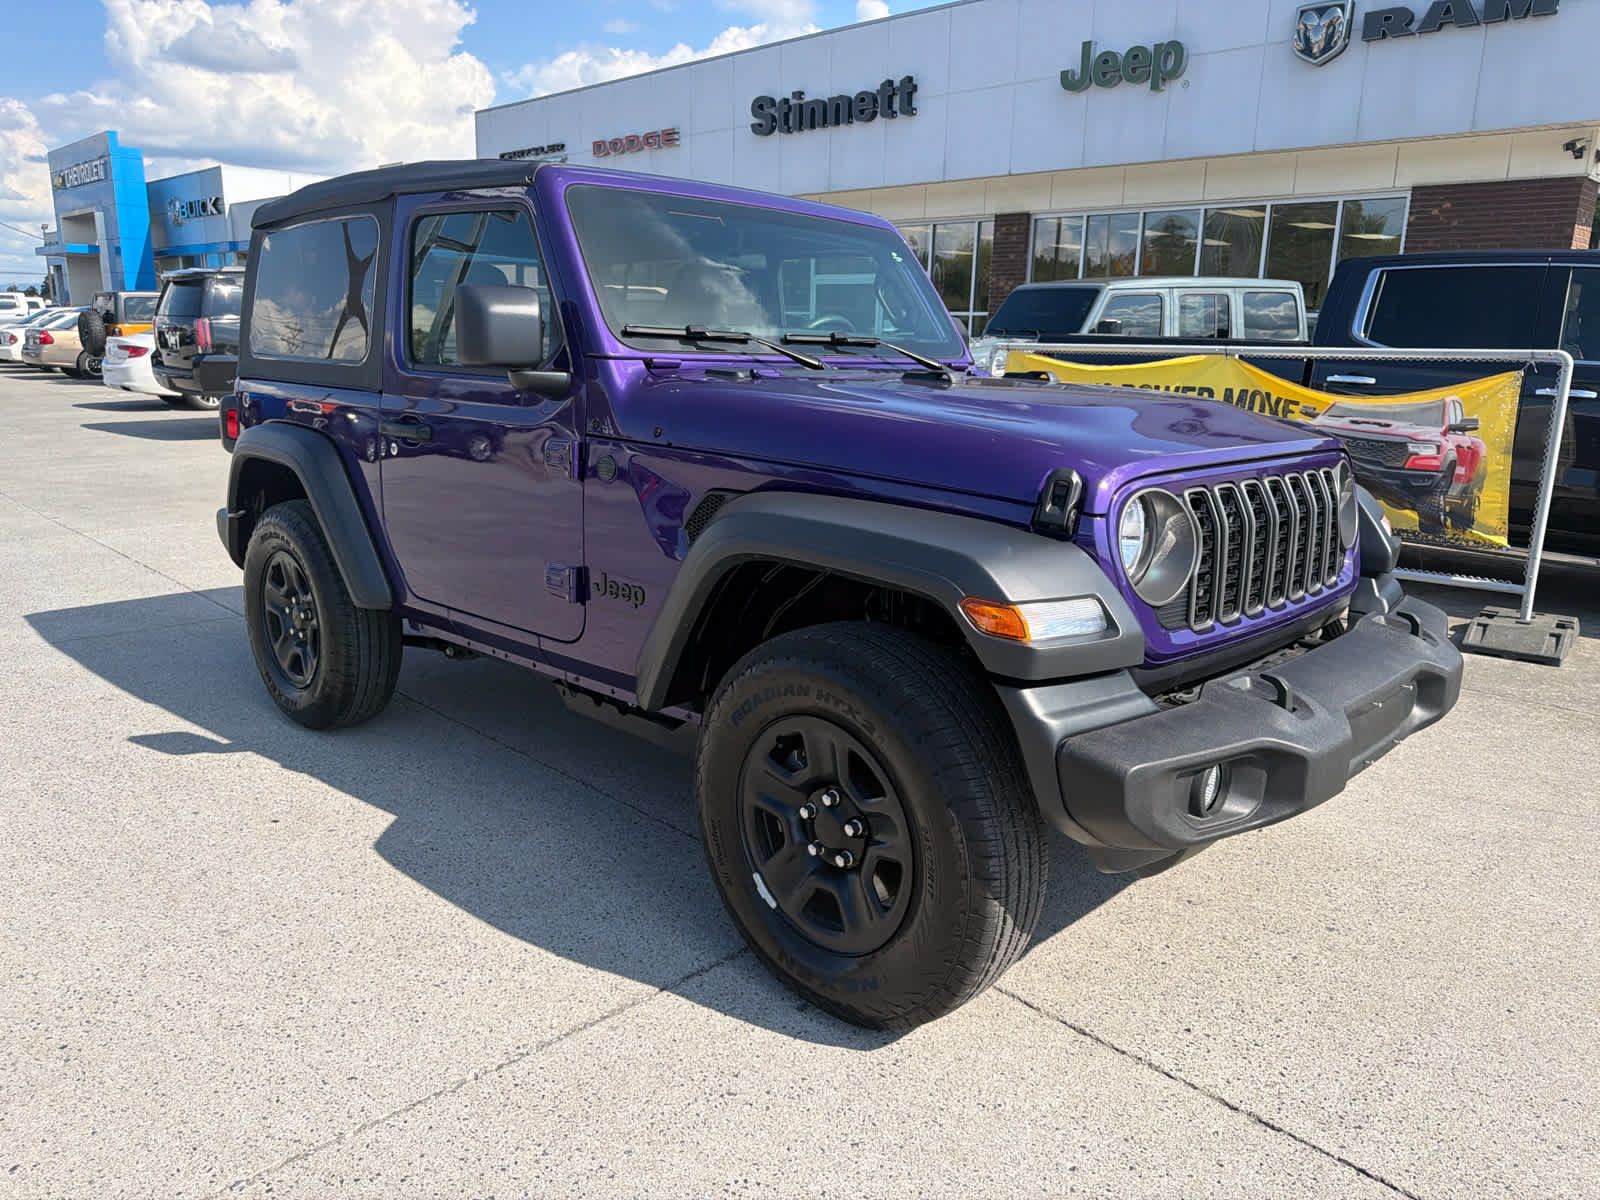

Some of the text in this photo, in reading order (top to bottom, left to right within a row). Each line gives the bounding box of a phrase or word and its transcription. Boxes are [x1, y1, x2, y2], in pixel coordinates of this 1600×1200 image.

[1361, 0, 1560, 41] RAM
[1060, 40, 1188, 93] Jeep
[751, 75, 918, 136] Stinnett
[592, 128, 680, 158] DODGE
[64, 158, 105, 188] CHEVROLET
[180, 196, 222, 219] BUICK
[592, 571, 646, 609] Jeep
